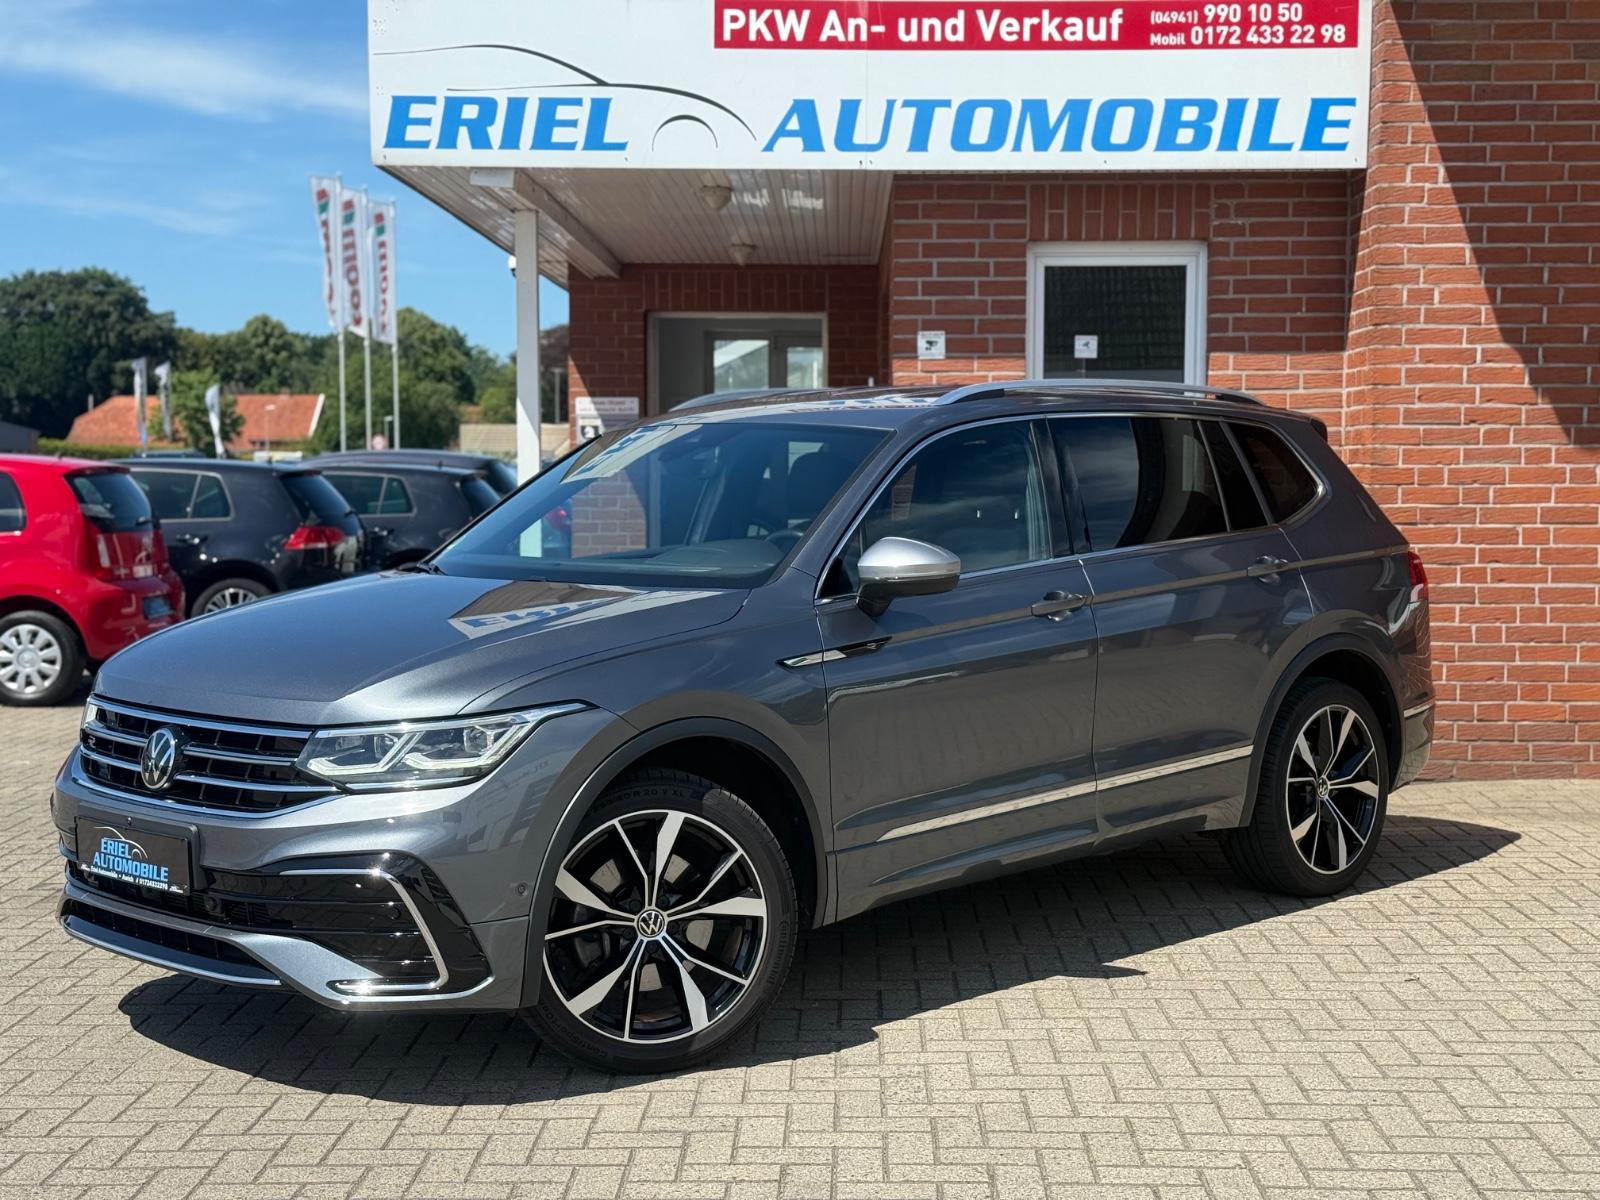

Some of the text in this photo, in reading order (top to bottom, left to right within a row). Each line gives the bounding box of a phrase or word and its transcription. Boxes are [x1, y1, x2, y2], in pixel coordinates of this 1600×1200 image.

[722, 8, 1124, 43] PKW An- und Verkauf
[1150, 3, 1303, 24] (04941) 990 10 50
[1150, 25, 1346, 45] Mobil 0172 433 22 98
[383, 95, 1358, 153] ERIEL AUTOMOBILE
[101, 838, 131, 859] ERIEL
[93, 852, 169, 882] AUTOMOBILE
